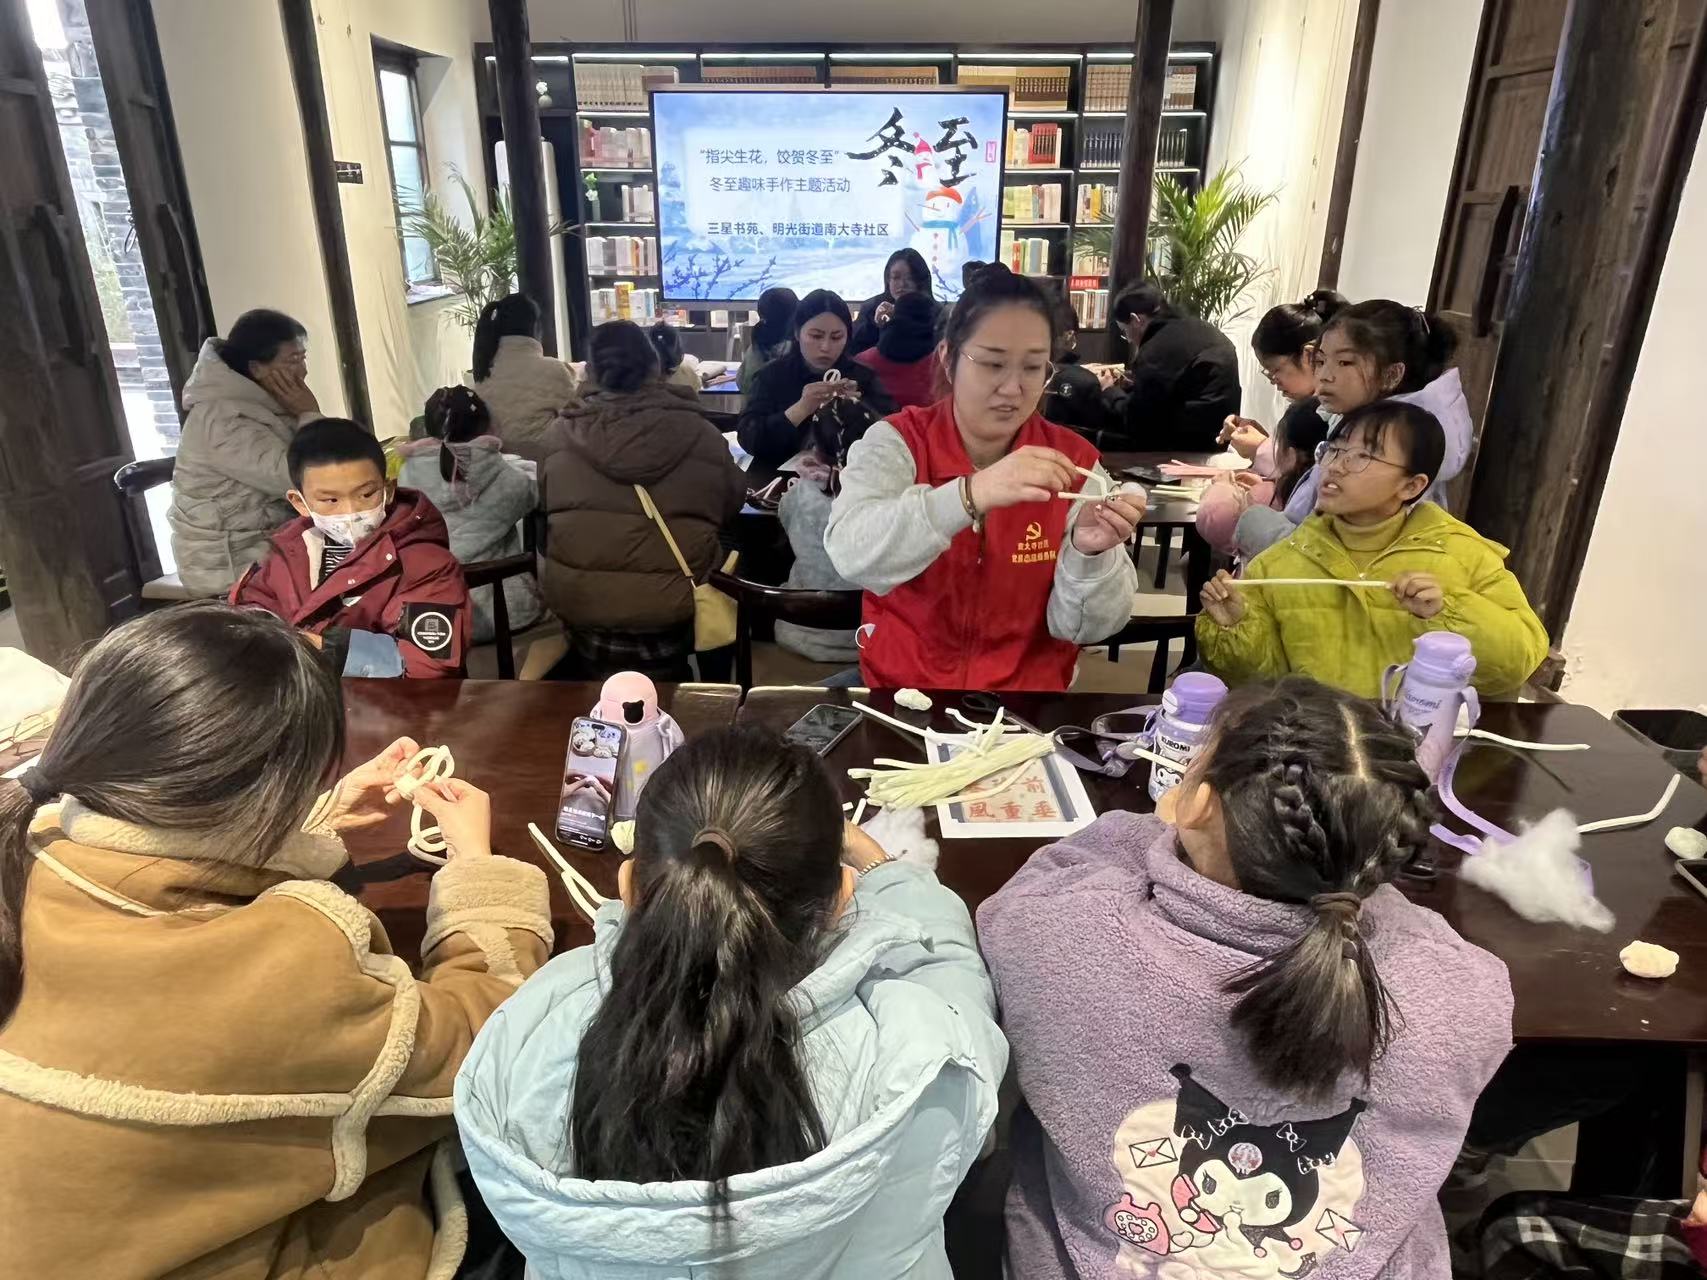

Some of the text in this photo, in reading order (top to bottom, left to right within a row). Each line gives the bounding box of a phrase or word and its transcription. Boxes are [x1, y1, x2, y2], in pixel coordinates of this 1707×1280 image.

[844, 106, 979, 188] 冬至
[709, 176, 851, 193] 冬至趣味手作主题活动
[707, 221, 889, 237] 三星书苑、明光街道南大寺社区
[1161, 735, 1191, 752] KUROMI
